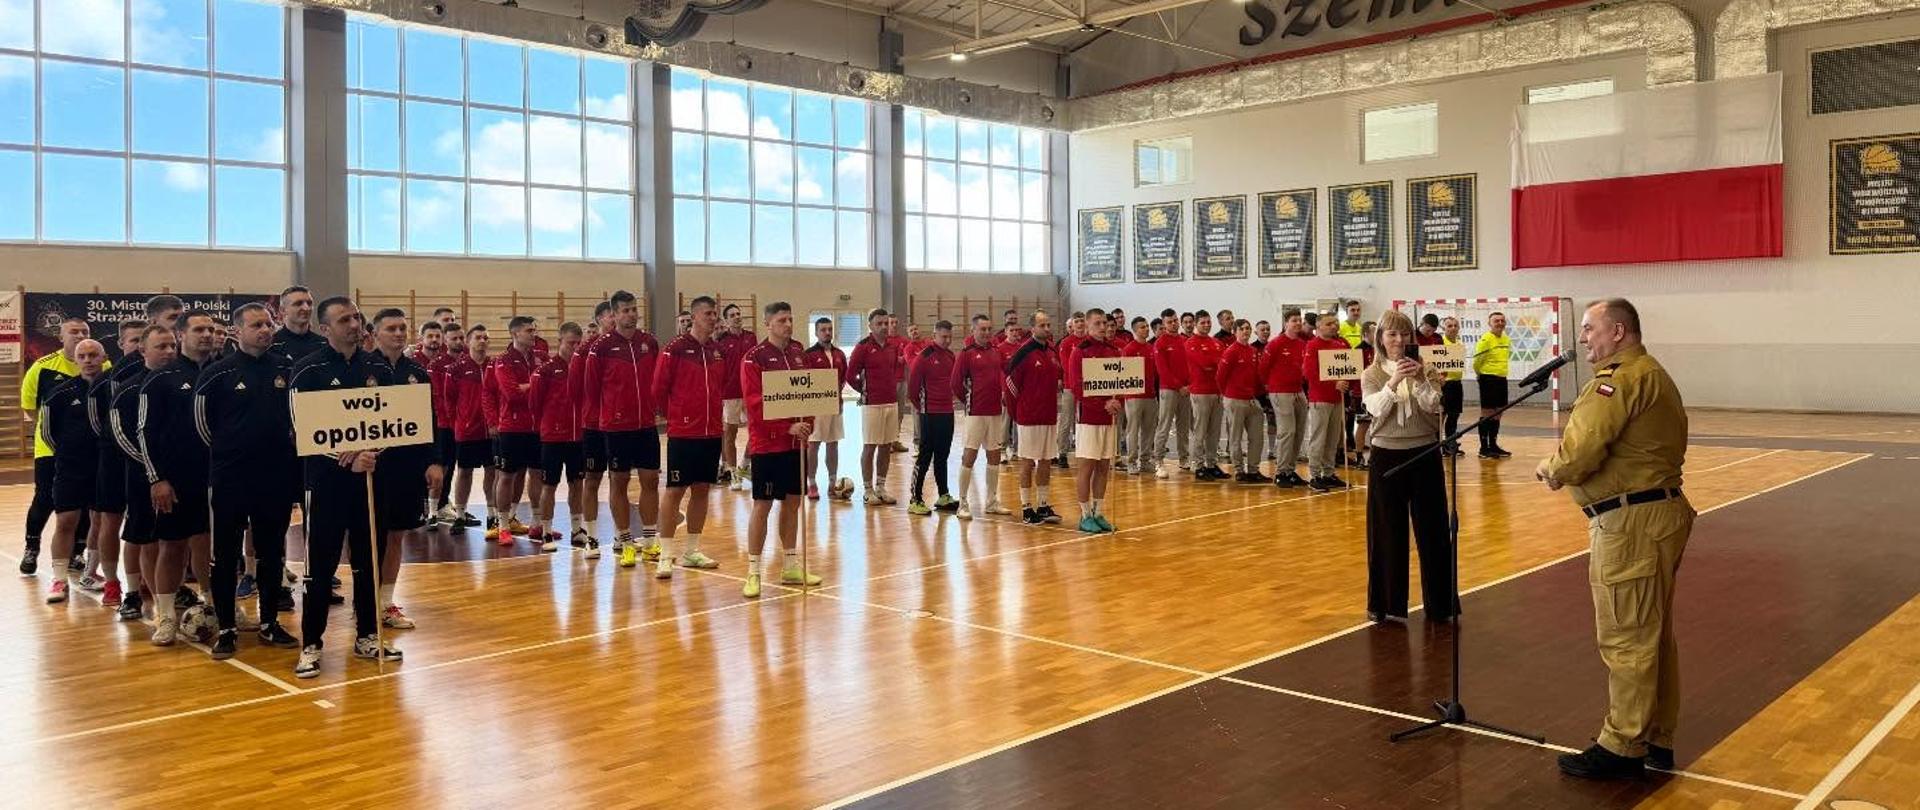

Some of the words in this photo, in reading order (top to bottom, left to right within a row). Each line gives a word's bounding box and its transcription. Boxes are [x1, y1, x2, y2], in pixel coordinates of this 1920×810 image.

[87, 300, 108, 311] 30.
[194, 300, 231, 311] Polski
[1334, 352, 1350, 363] woj.
[1433, 347, 1450, 357] woj.
[1103, 360, 1125, 373] woj.
[1327, 365, 1357, 378] śląskie
[789, 372, 813, 388] woj.
[1083, 376, 1144, 391] mazowieckie
[342, 393, 387, 412] woj.
[763, 390, 838, 402] zachodniopomorskie
[313, 418, 418, 449] opolskie
